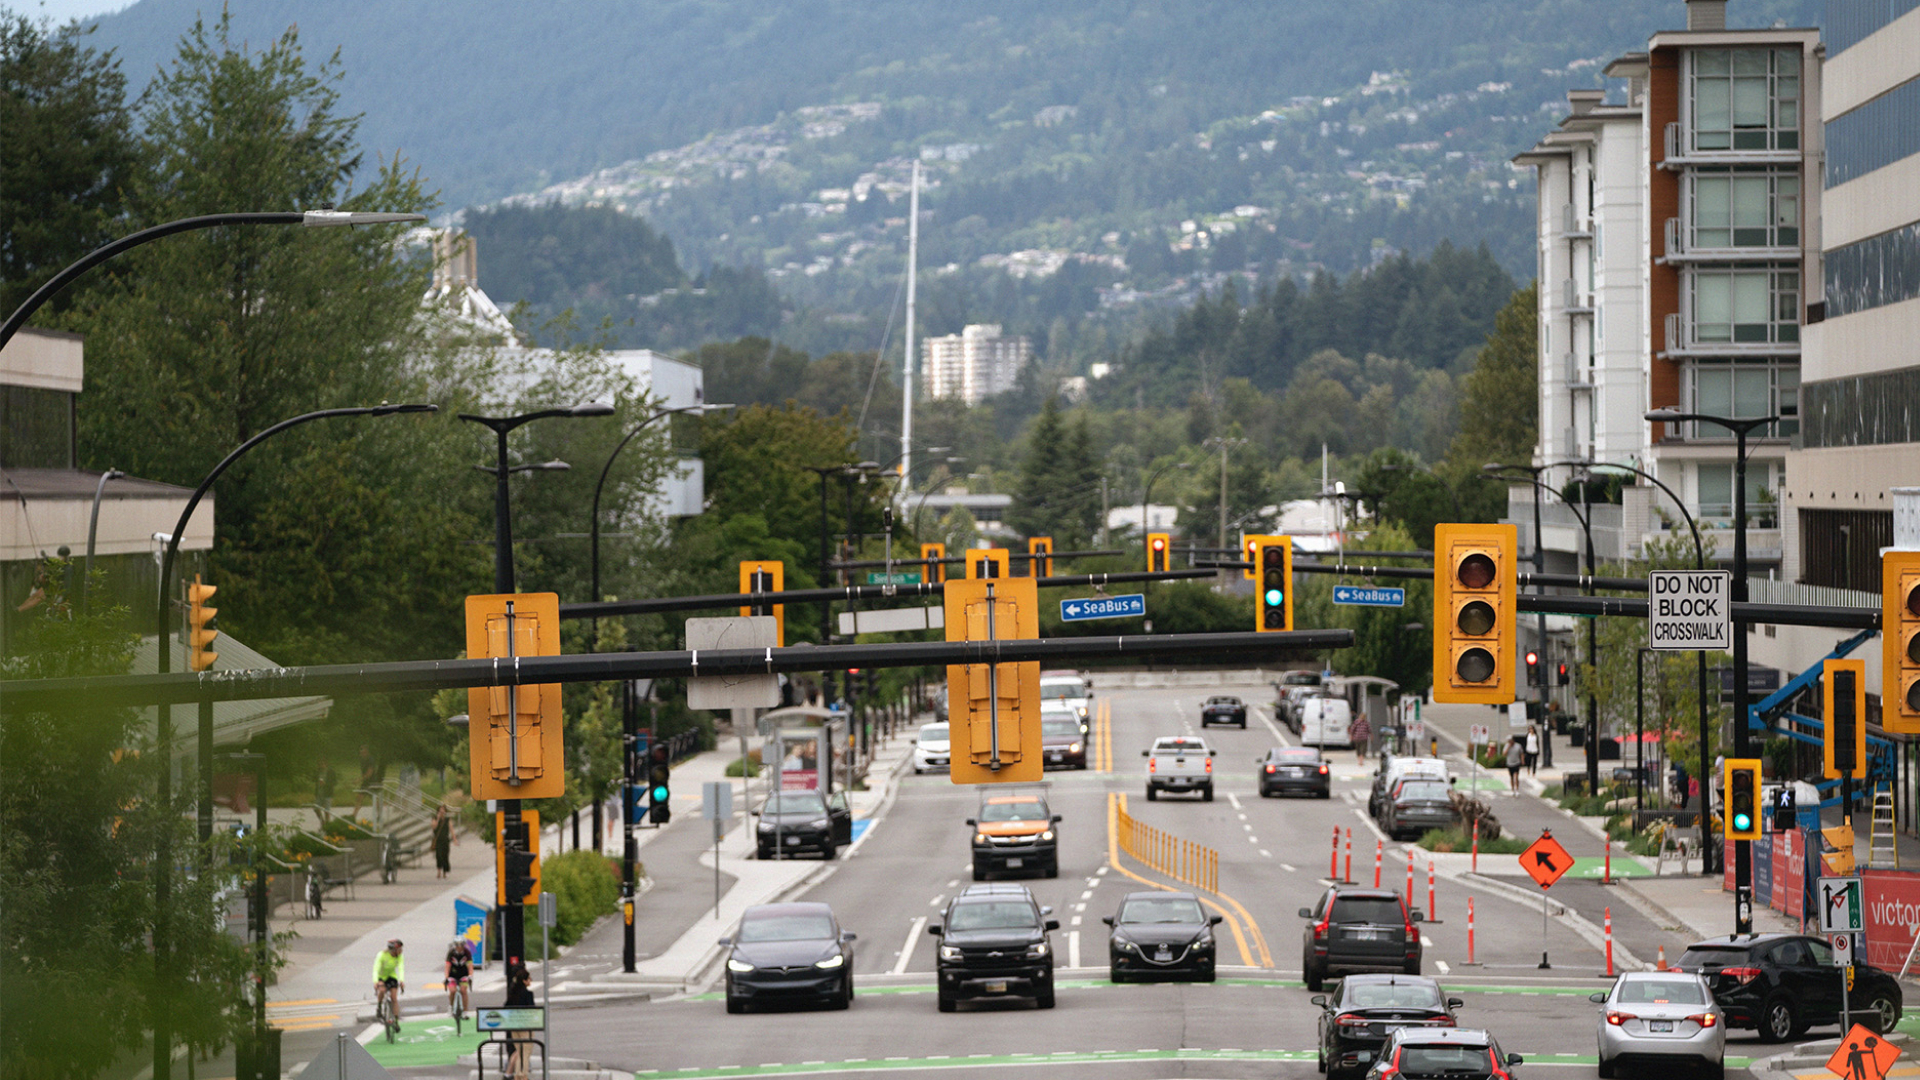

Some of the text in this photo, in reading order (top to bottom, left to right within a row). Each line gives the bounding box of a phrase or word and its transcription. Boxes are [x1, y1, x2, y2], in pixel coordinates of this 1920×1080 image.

[1655, 576, 1723, 594] DO NOT
[1352, 589, 1391, 601] SeaBus
[1083, 600, 1129, 614] SeaBus
[1659, 598, 1718, 616] BLOCK
[1654, 622, 1723, 640] CROSSWALK
[1871, 893, 1920, 927] victor
